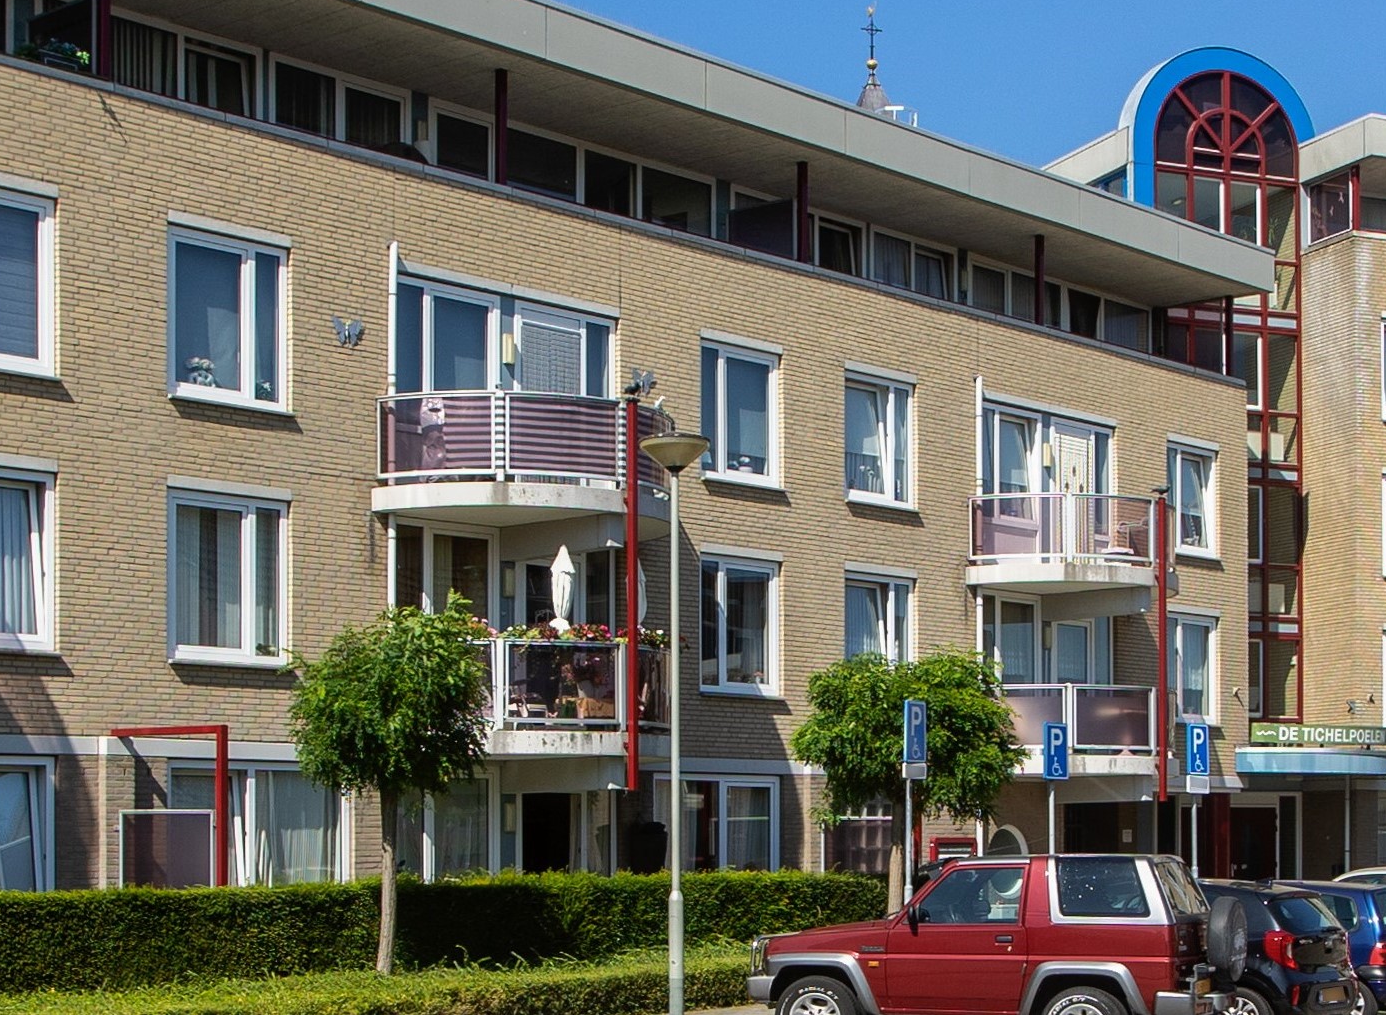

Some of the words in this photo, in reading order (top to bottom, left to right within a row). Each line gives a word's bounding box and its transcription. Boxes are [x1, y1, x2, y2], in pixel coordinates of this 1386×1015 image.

[911, 706, 922, 736] P
[1278, 726, 1298, 741] DE
[1051, 728, 1063, 755] P
[1193, 728, 1204, 753] P
